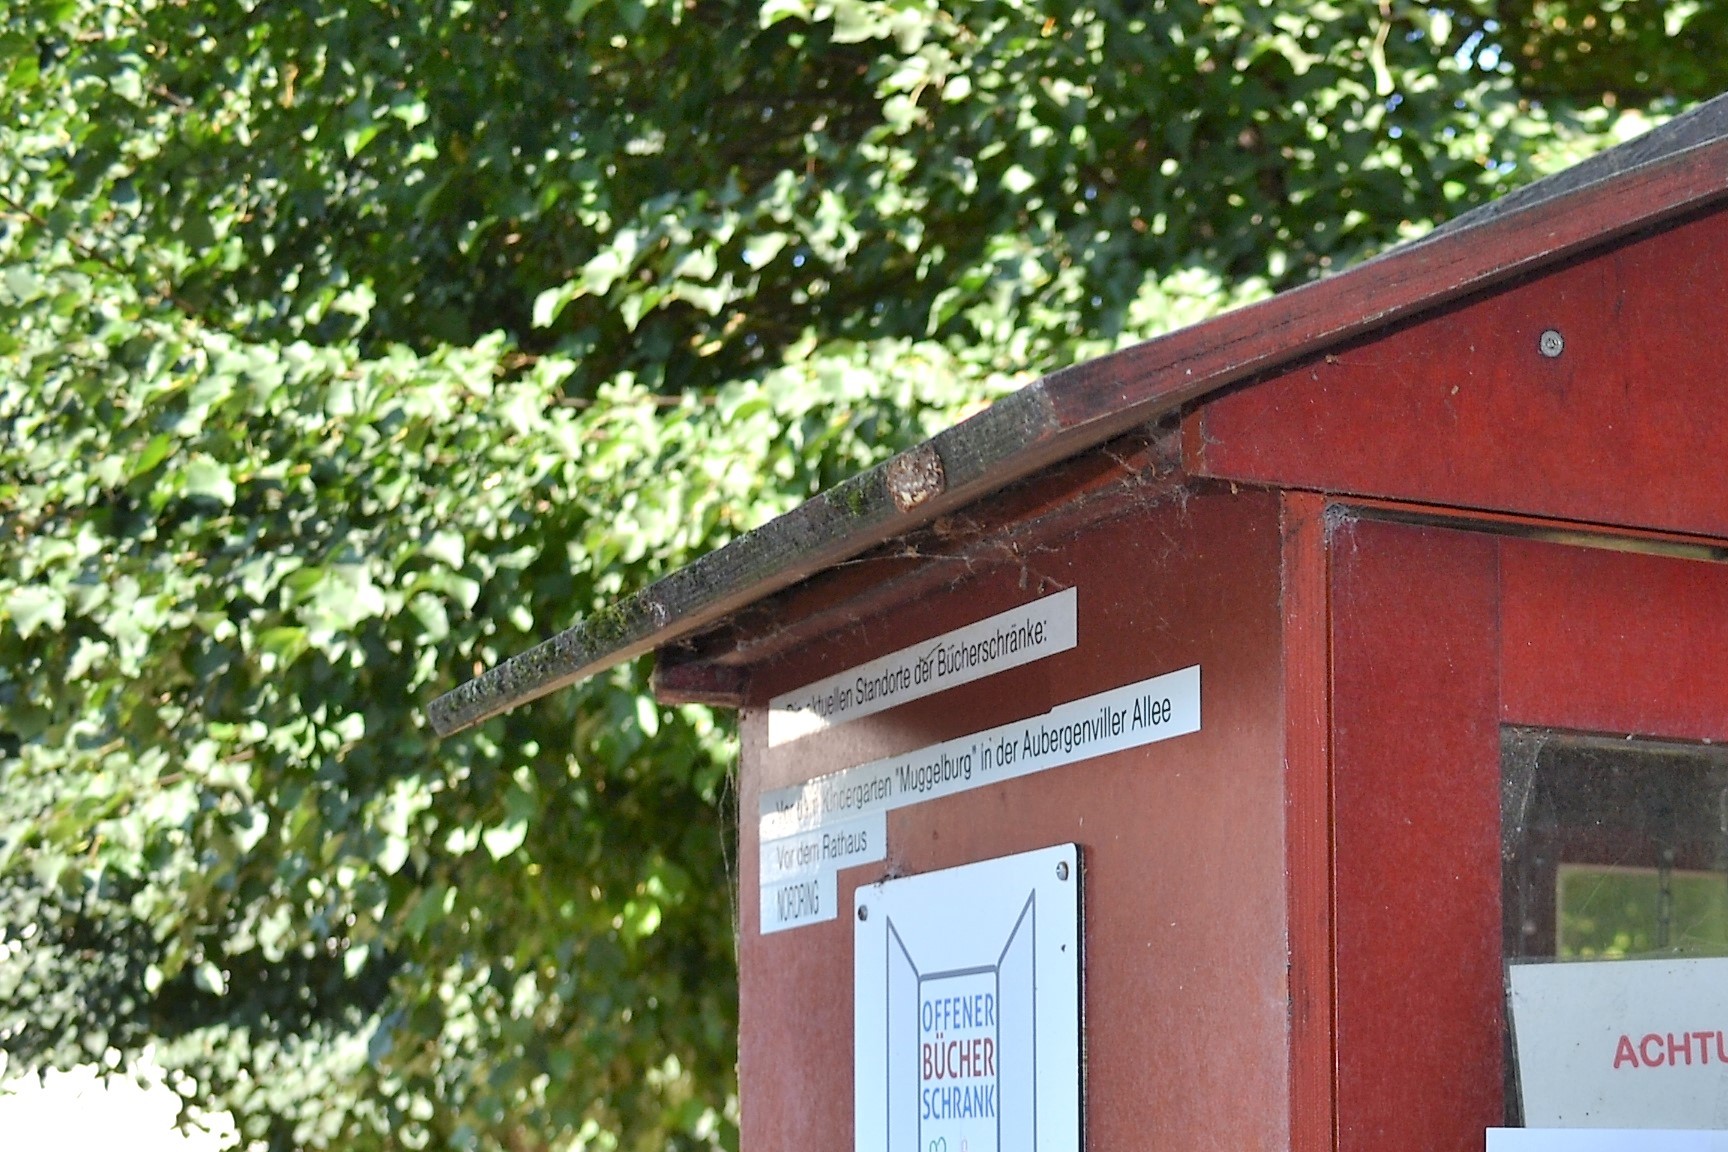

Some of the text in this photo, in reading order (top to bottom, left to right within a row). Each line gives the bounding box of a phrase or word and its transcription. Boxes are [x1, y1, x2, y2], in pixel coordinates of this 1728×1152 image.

[806, 618, 1048, 717] ktuellen Standorte der Bücherschränke:
[821, 776, 892, 812] Kindergarten
[895, 746, 977, 793] "Muggelburg"
[980, 741, 992, 771] in
[996, 738, 1019, 767] der
[1022, 706, 1127, 760] Aubergenviller
[1131, 695, 1172, 731] Allee
[776, 831, 867, 870] Vor dem Rathaus
[777, 880, 819, 922] NORDRING
[922, 993, 995, 1032] OFFENER
[923, 1033, 995, 1080] BÜCHER
[923, 1084, 995, 1120] SCHRANK
